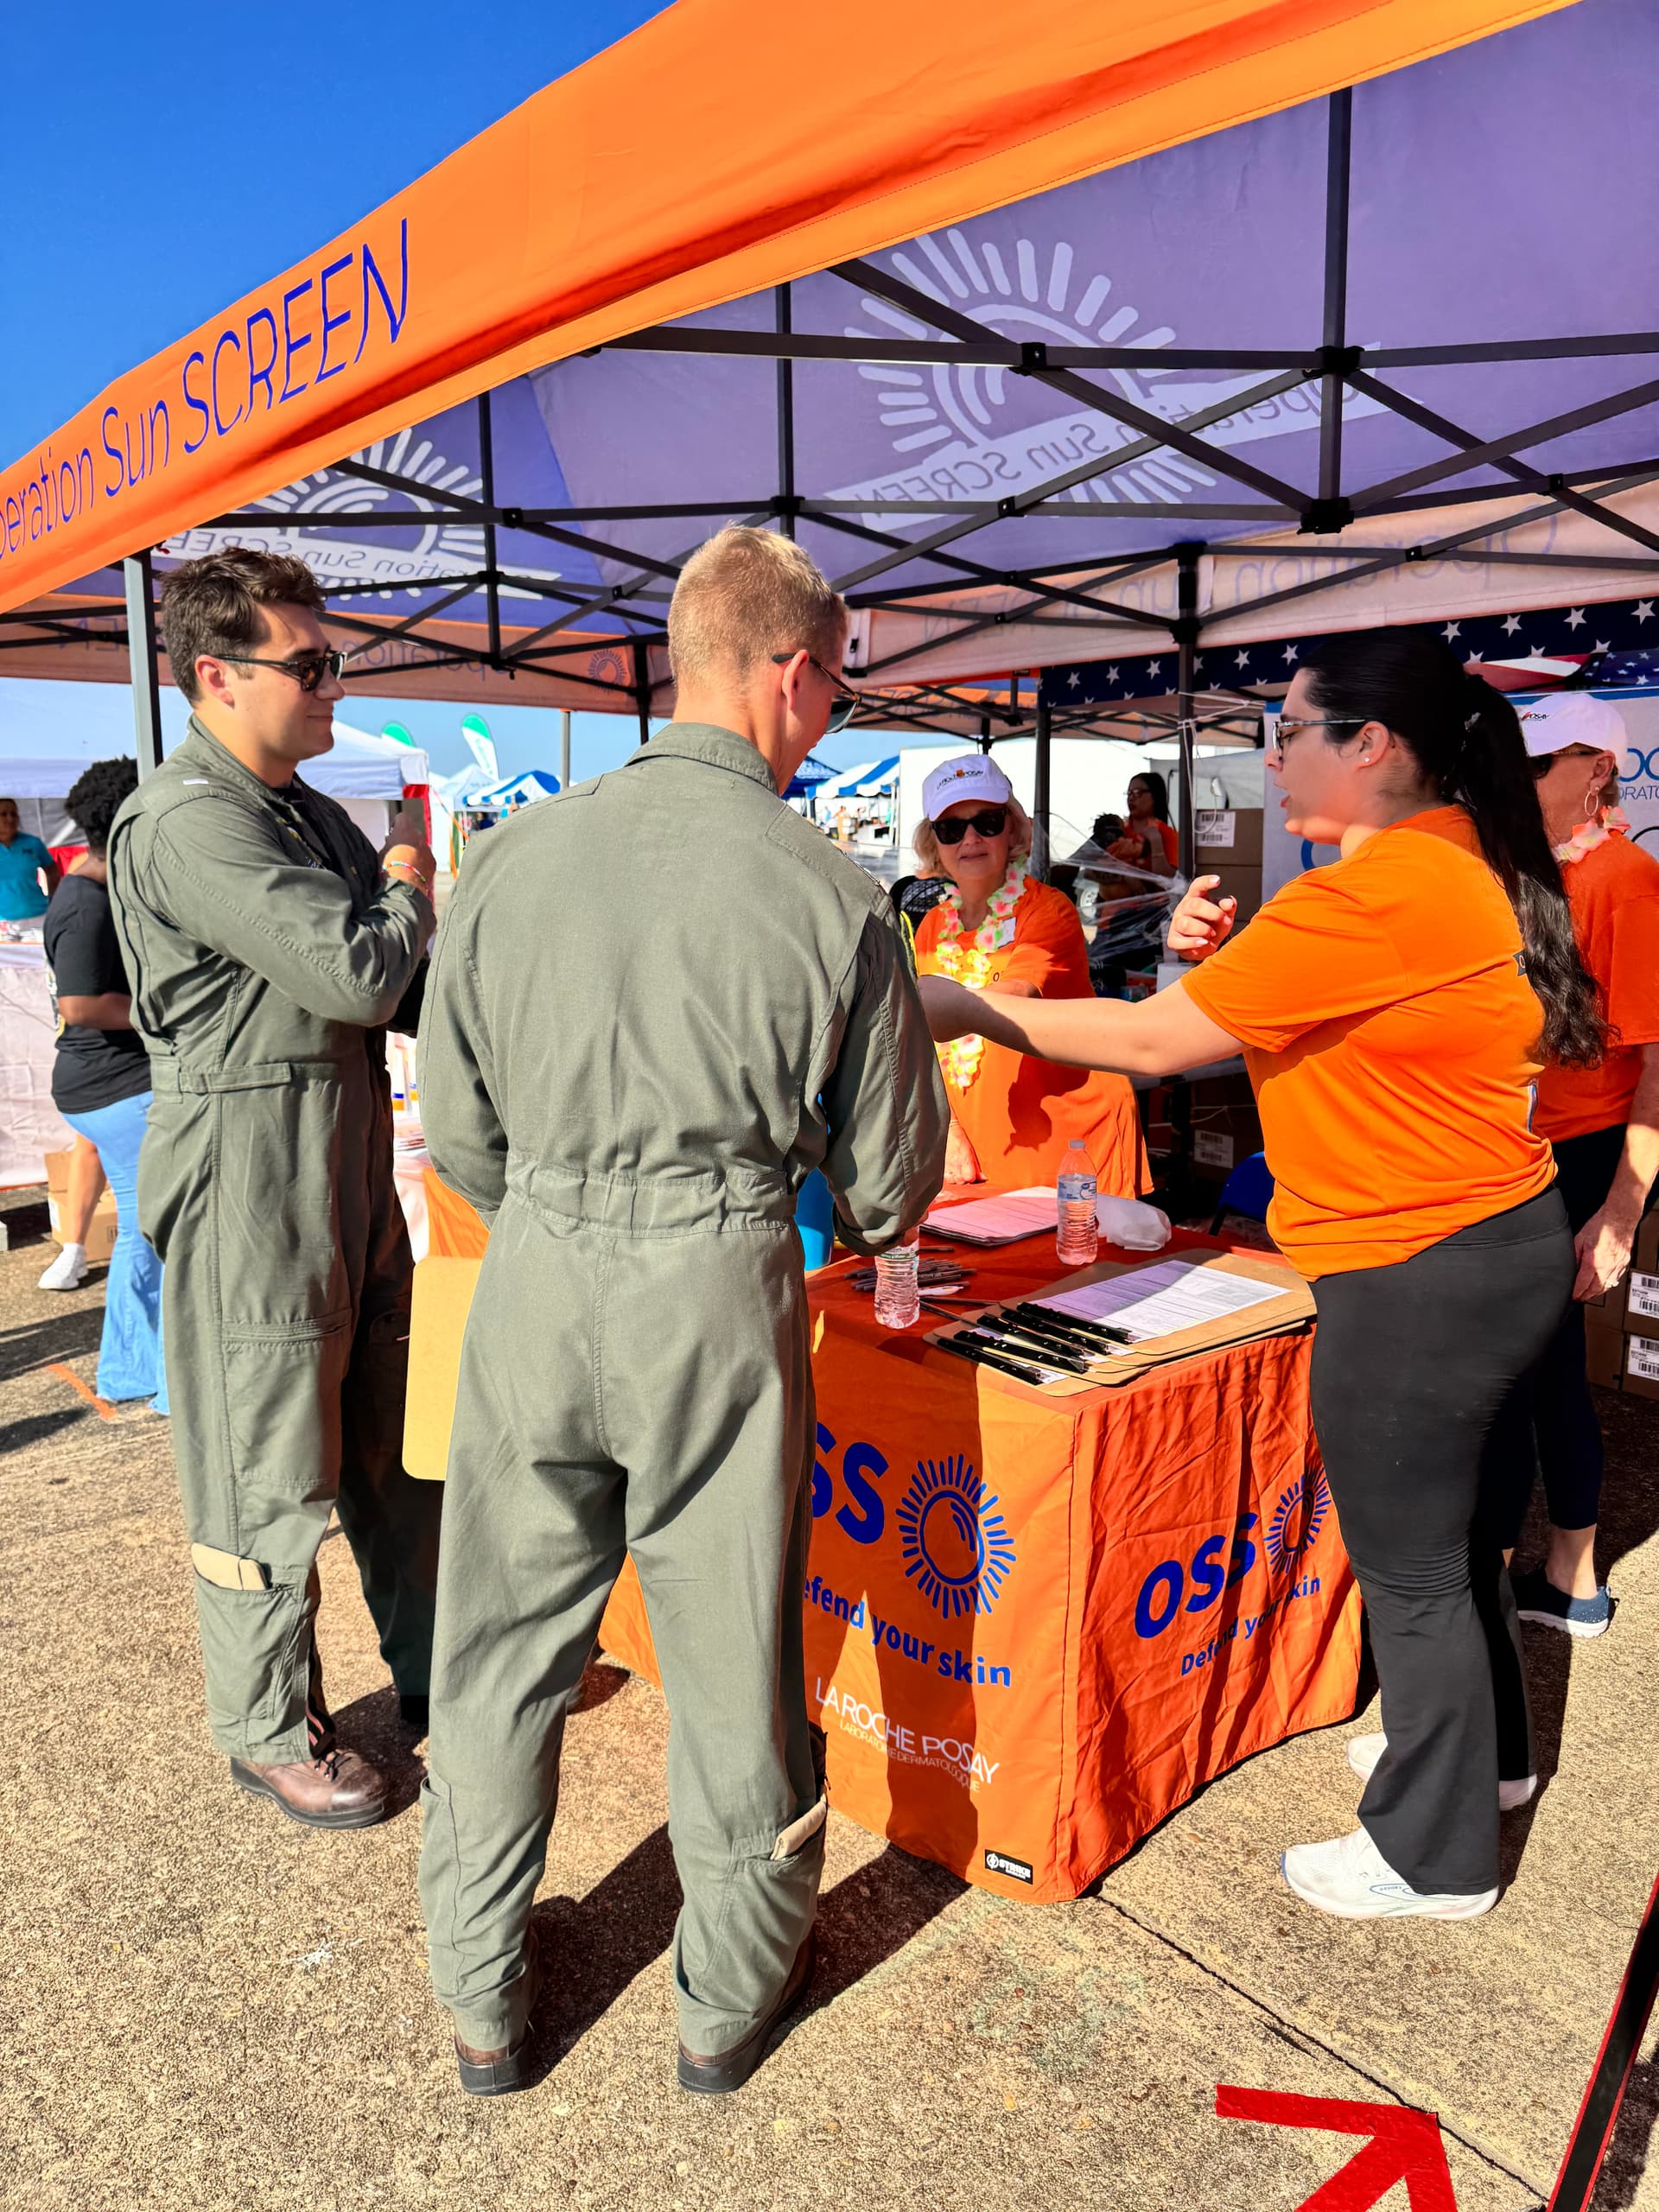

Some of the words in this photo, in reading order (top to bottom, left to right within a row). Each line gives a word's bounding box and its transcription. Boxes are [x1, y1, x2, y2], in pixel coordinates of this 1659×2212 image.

[101, 400, 169, 497] Sun
[181, 217, 407, 454] SCREEN
[804, 1576, 865, 1630] fend
[871, 1614, 935, 1665] your
[938, 1649, 1011, 1688] skin
[1135, 1512, 1258, 1638] OSS
[842, 1693, 916, 1754] ROCHE
[922, 1736, 1000, 1784] POSAY
